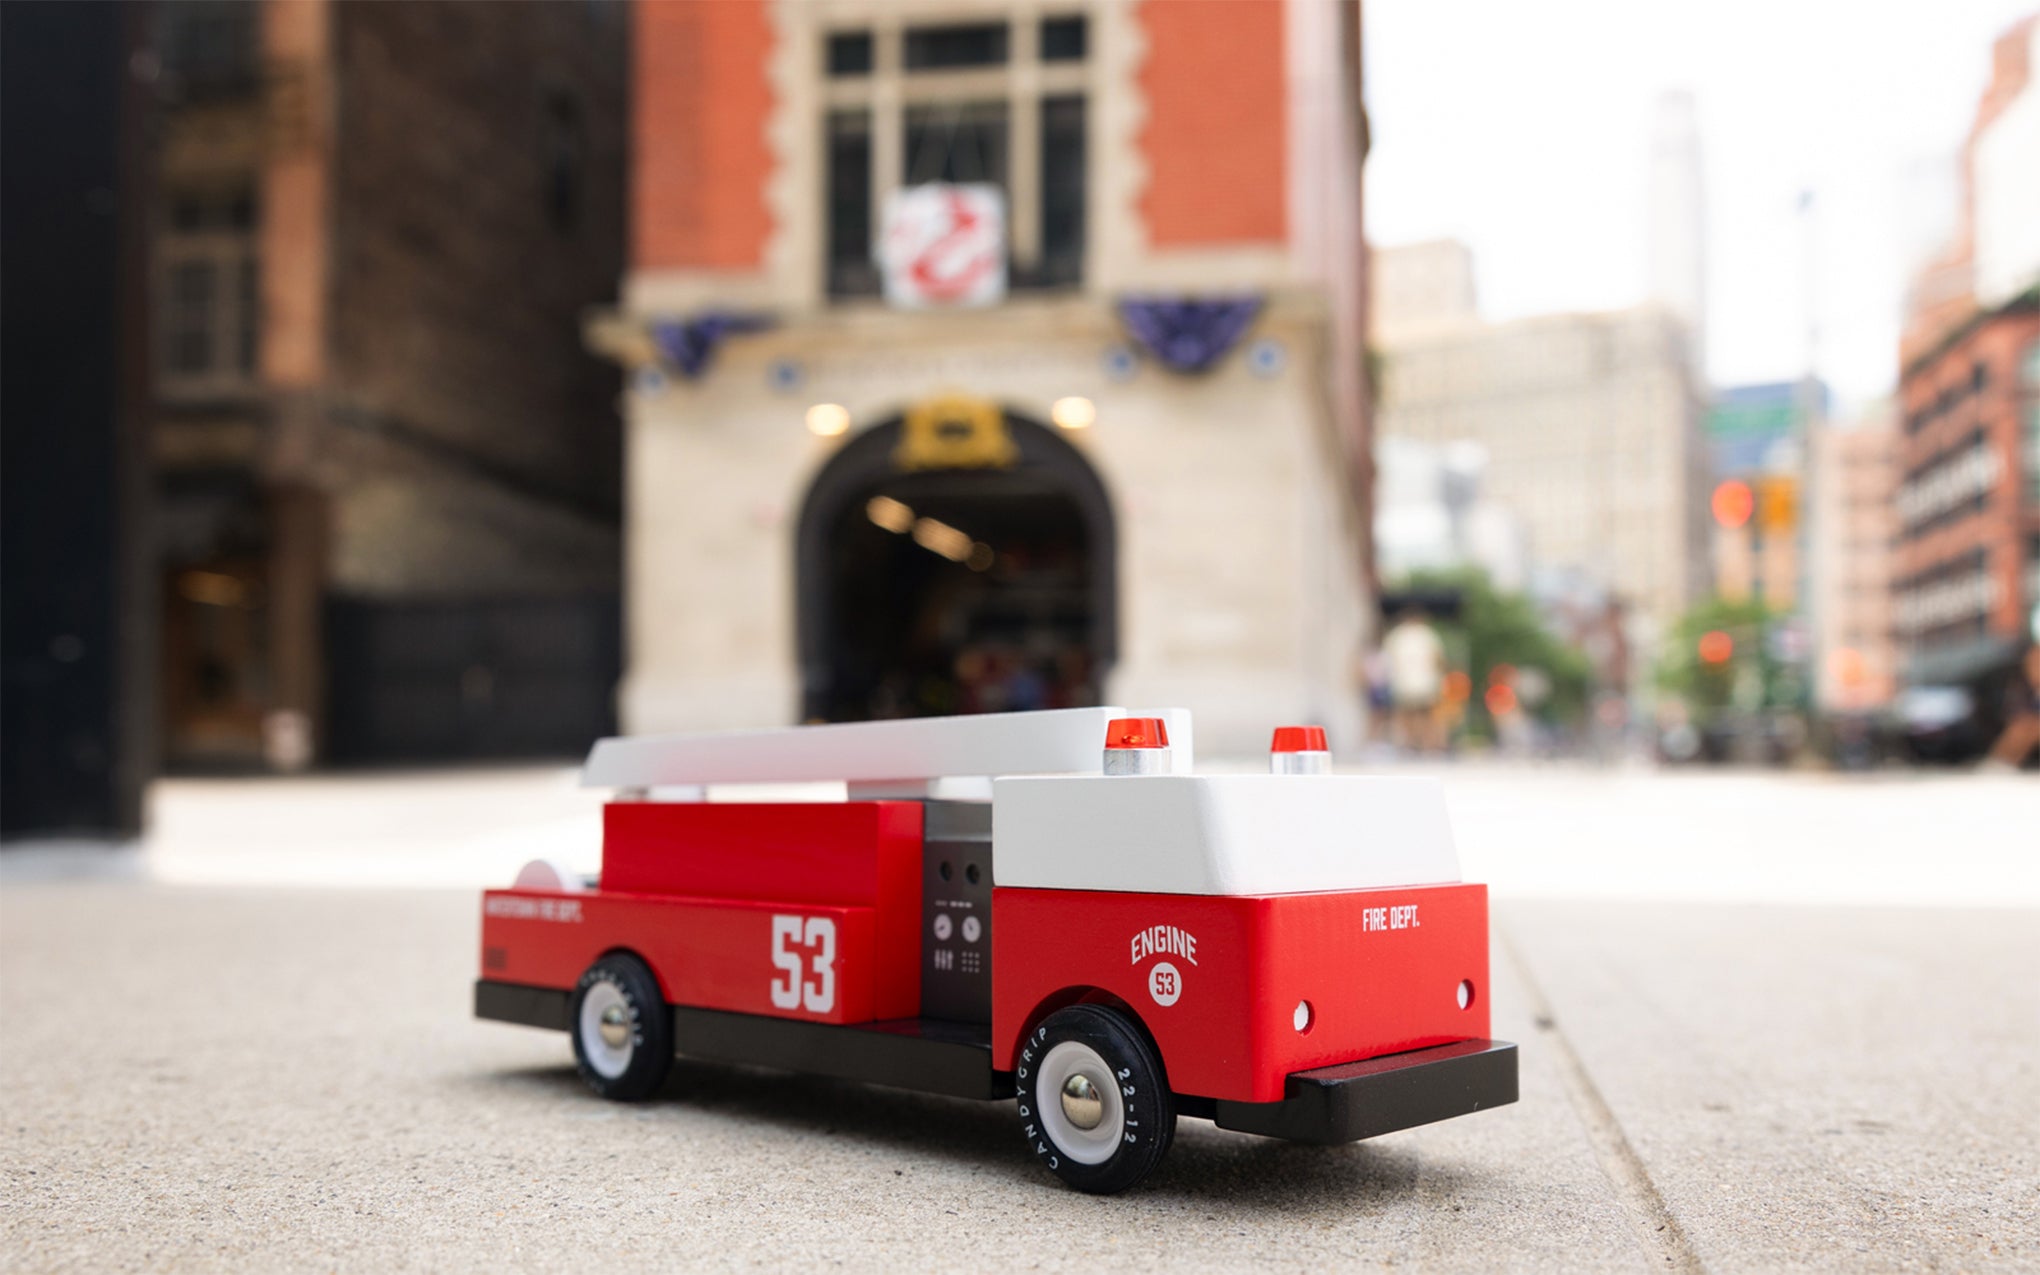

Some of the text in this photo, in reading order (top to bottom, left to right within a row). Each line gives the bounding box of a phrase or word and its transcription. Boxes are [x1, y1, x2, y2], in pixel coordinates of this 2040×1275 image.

[1131, 925, 1198, 967] ENGINE
[1363, 905, 1420, 932] FIRE DEPT.
[772, 914, 835, 1013] 53
[1155, 972, 1175, 995] 53
[1017, 1027, 1059, 1169] CANDYGRIP
[1117, 1068, 1138, 1143] 22-12
